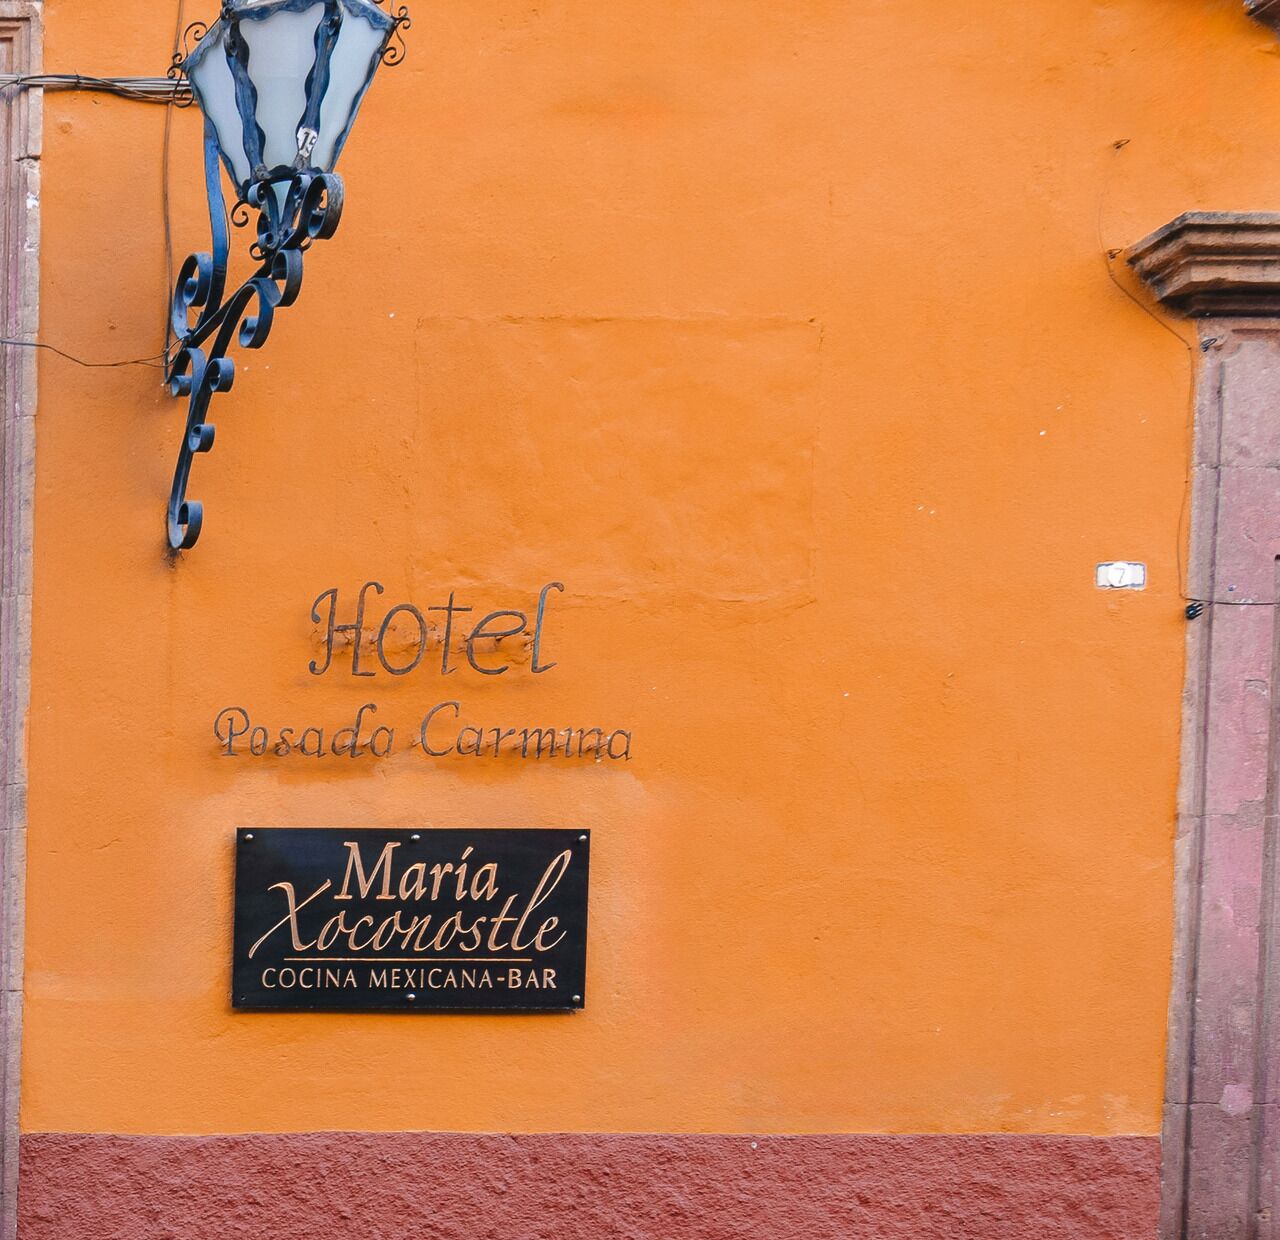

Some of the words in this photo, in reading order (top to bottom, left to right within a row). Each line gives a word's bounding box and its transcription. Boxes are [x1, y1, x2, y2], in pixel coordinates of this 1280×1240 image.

[308, 582, 565, 677] Hotel
[214, 703, 394, 757] Posada
[419, 701, 633, 761] Carmina
[333, 842, 498, 901] María
[248, 849, 572, 959] Xoconostle
[261, 967, 358, 989] COCINA
